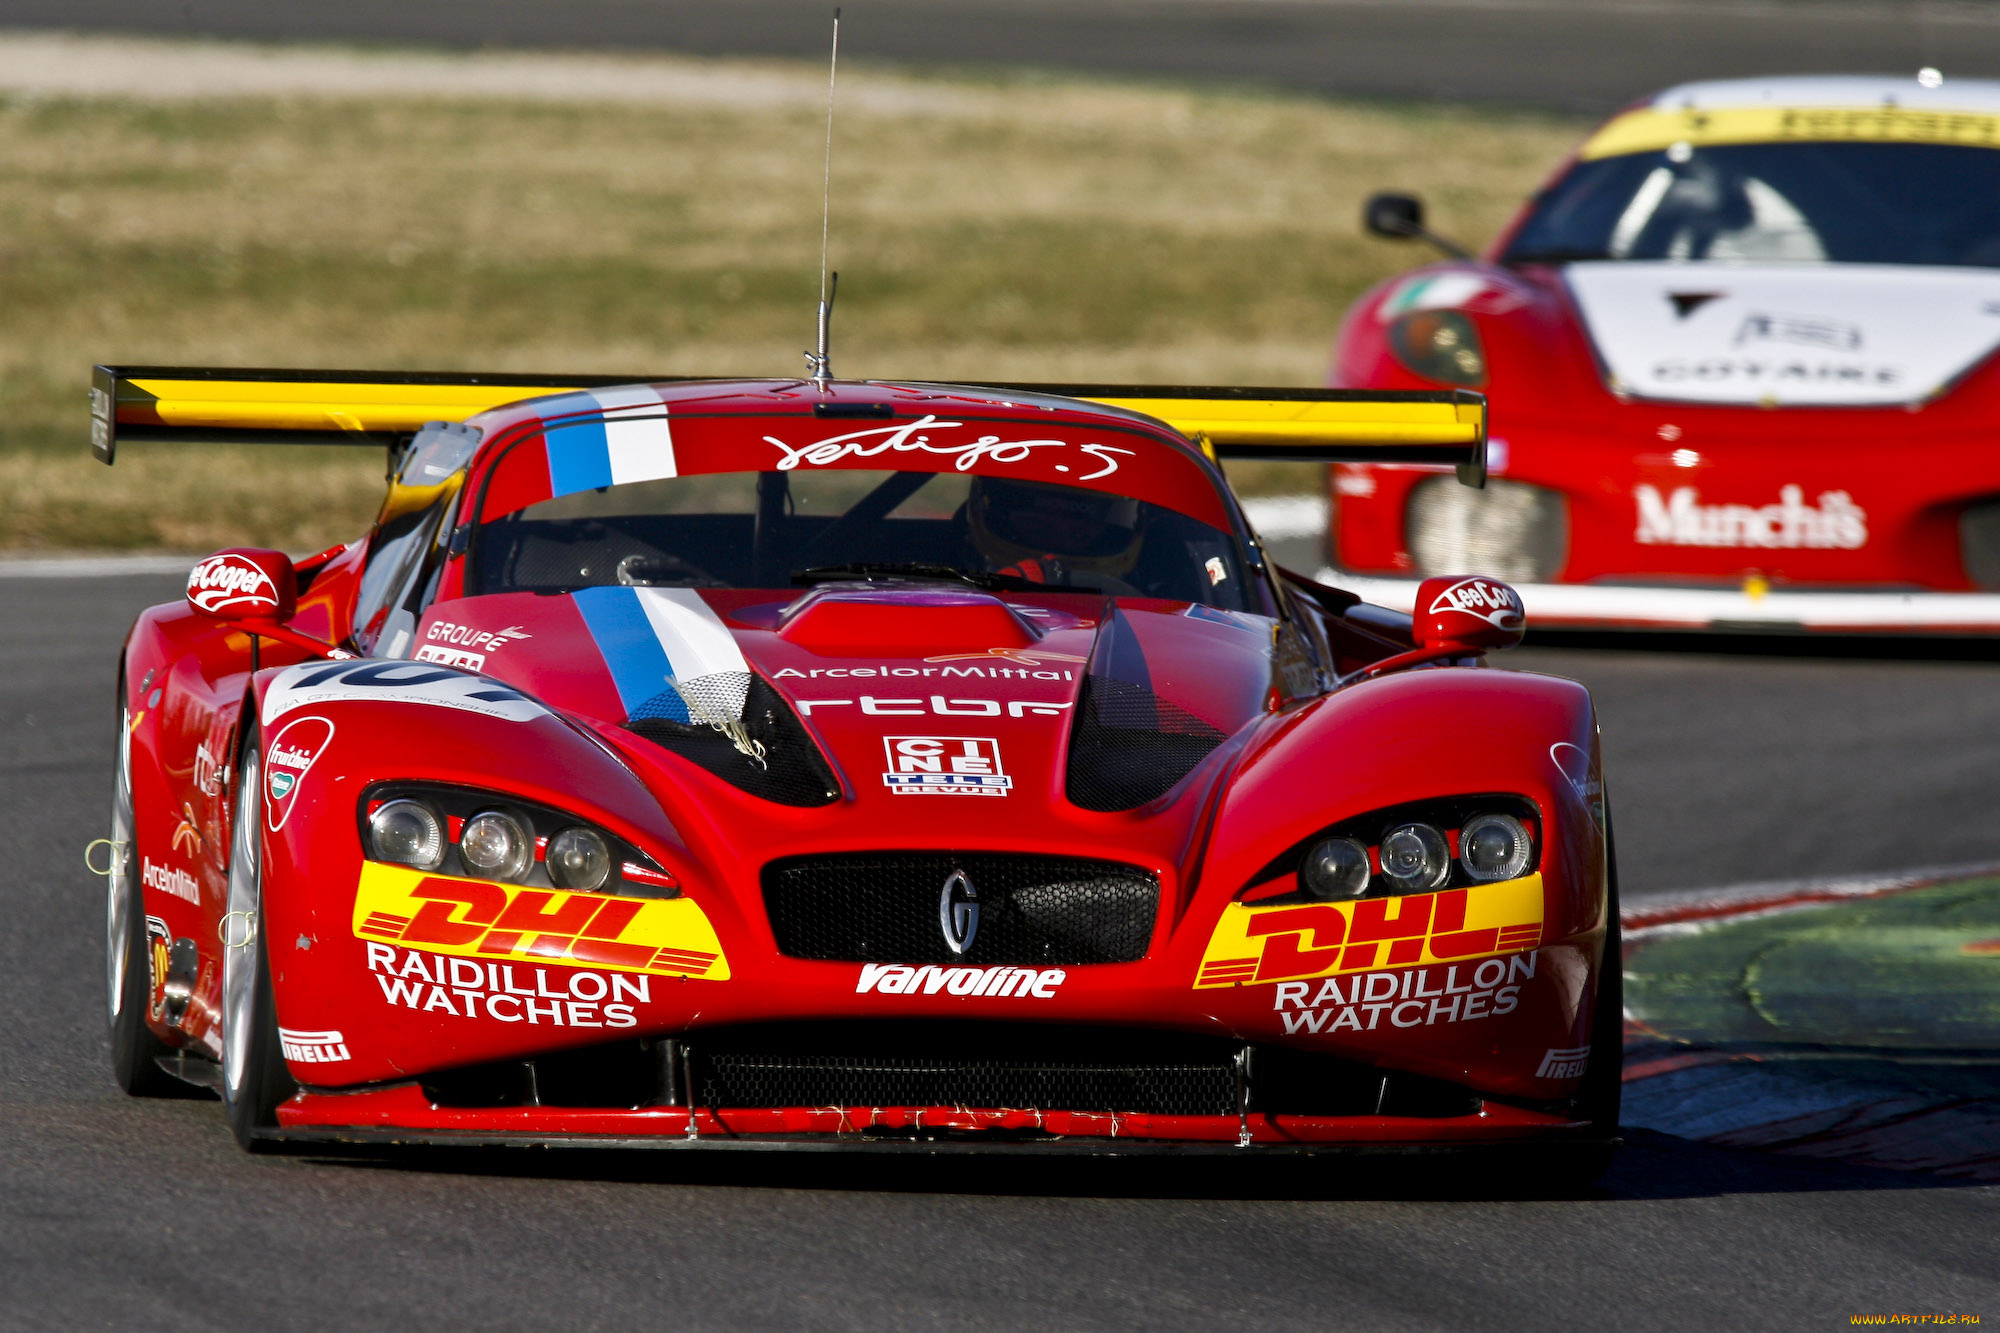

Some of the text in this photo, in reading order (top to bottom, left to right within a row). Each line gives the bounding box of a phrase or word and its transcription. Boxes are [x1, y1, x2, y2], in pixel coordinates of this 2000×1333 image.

[426, 620, 509, 652] GROUPE
[772, 666, 1073, 681] ArcelorMittal
[307, 693, 337, 701] GT
[795, 695, 1074, 718] rtbf
[889, 774, 1007, 787] TELE
[901, 786, 999, 795] REVUE
[400, 876, 660, 968] DHL
[1245, 889, 1500, 982] DHL
[366, 941, 651, 1003] RAIDILLON
[856, 963, 1067, 999] Valvoline
[1273, 949, 1538, 1011] RAIDILLON
[375, 973, 638, 1028] WATCHES
[1279, 985, 1521, 1035] WATCHES
[278, 1027, 352, 1063] PIRELLI
